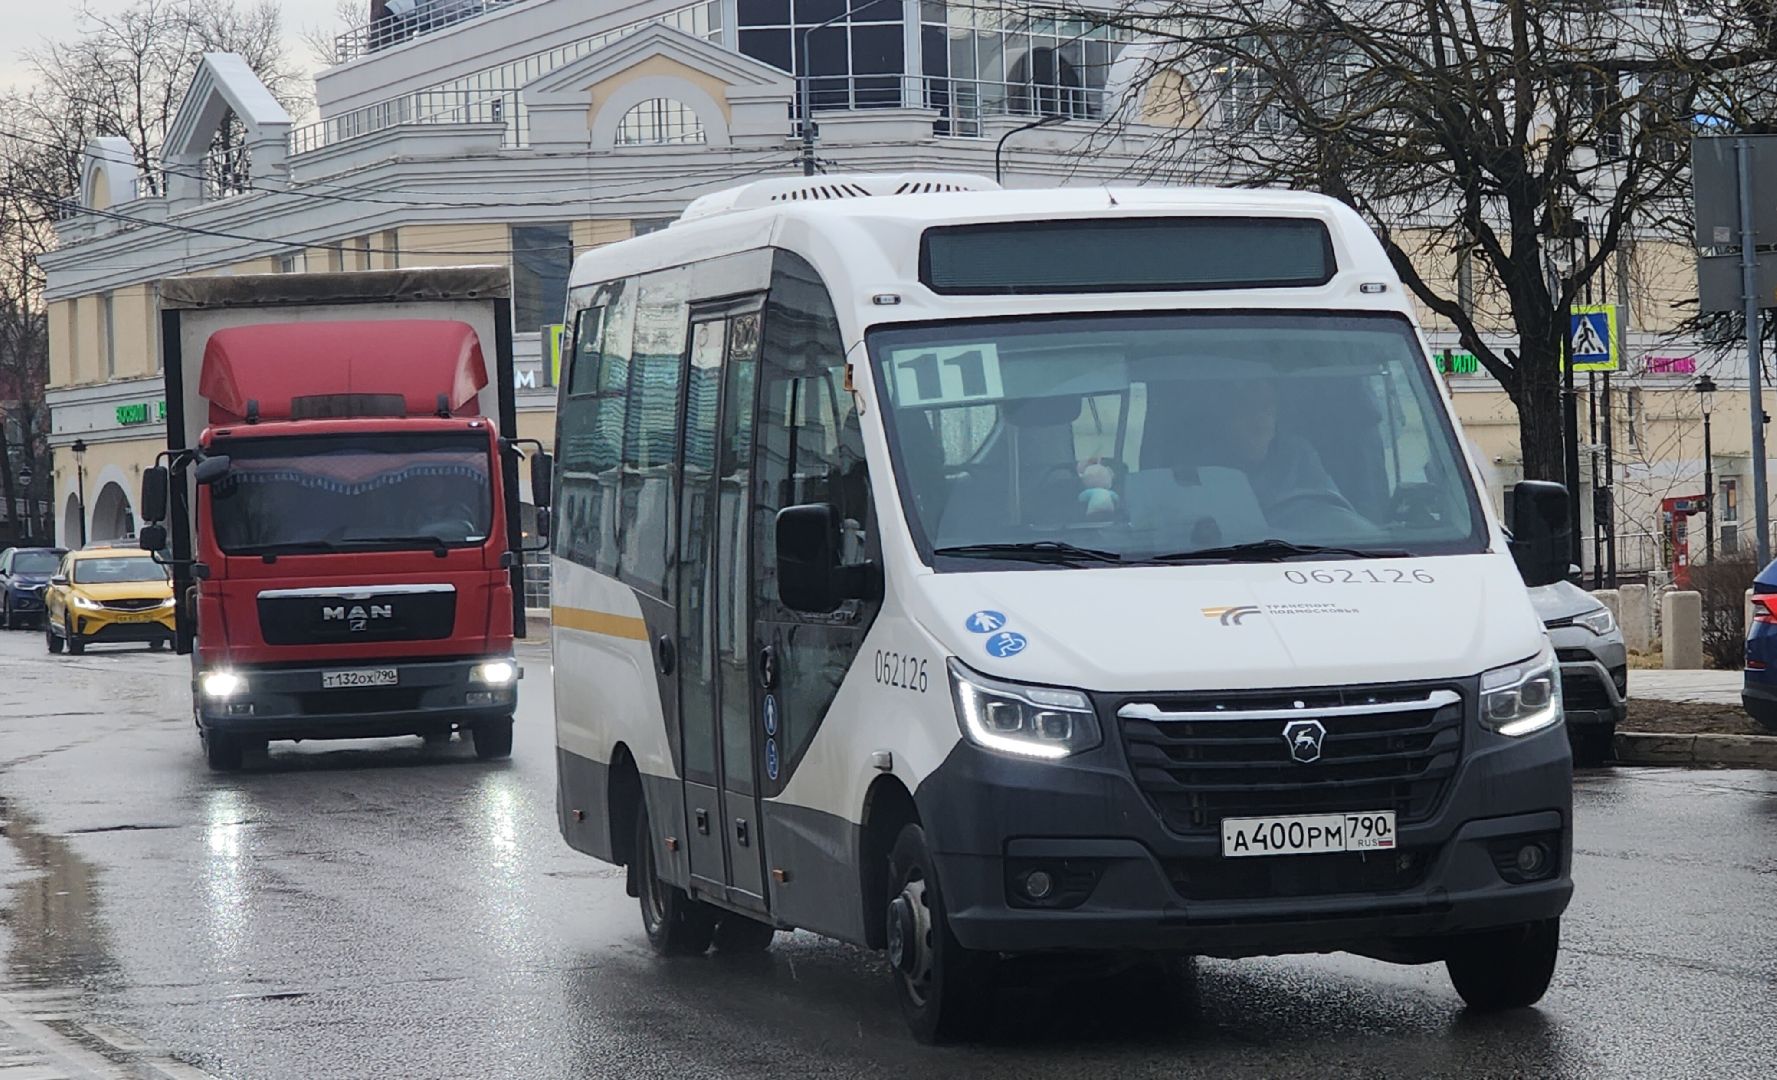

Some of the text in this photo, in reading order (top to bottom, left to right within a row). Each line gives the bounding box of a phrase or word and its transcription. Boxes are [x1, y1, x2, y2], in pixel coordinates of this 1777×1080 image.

[898, 350, 988, 400] 11
[1285, 568, 1435, 585] 062126
[323, 605, 393, 620] MAN
[875, 648, 928, 693] 062126
[1347, 816, 1388, 838] 790
[1358, 838, 1378, 848] RUS
